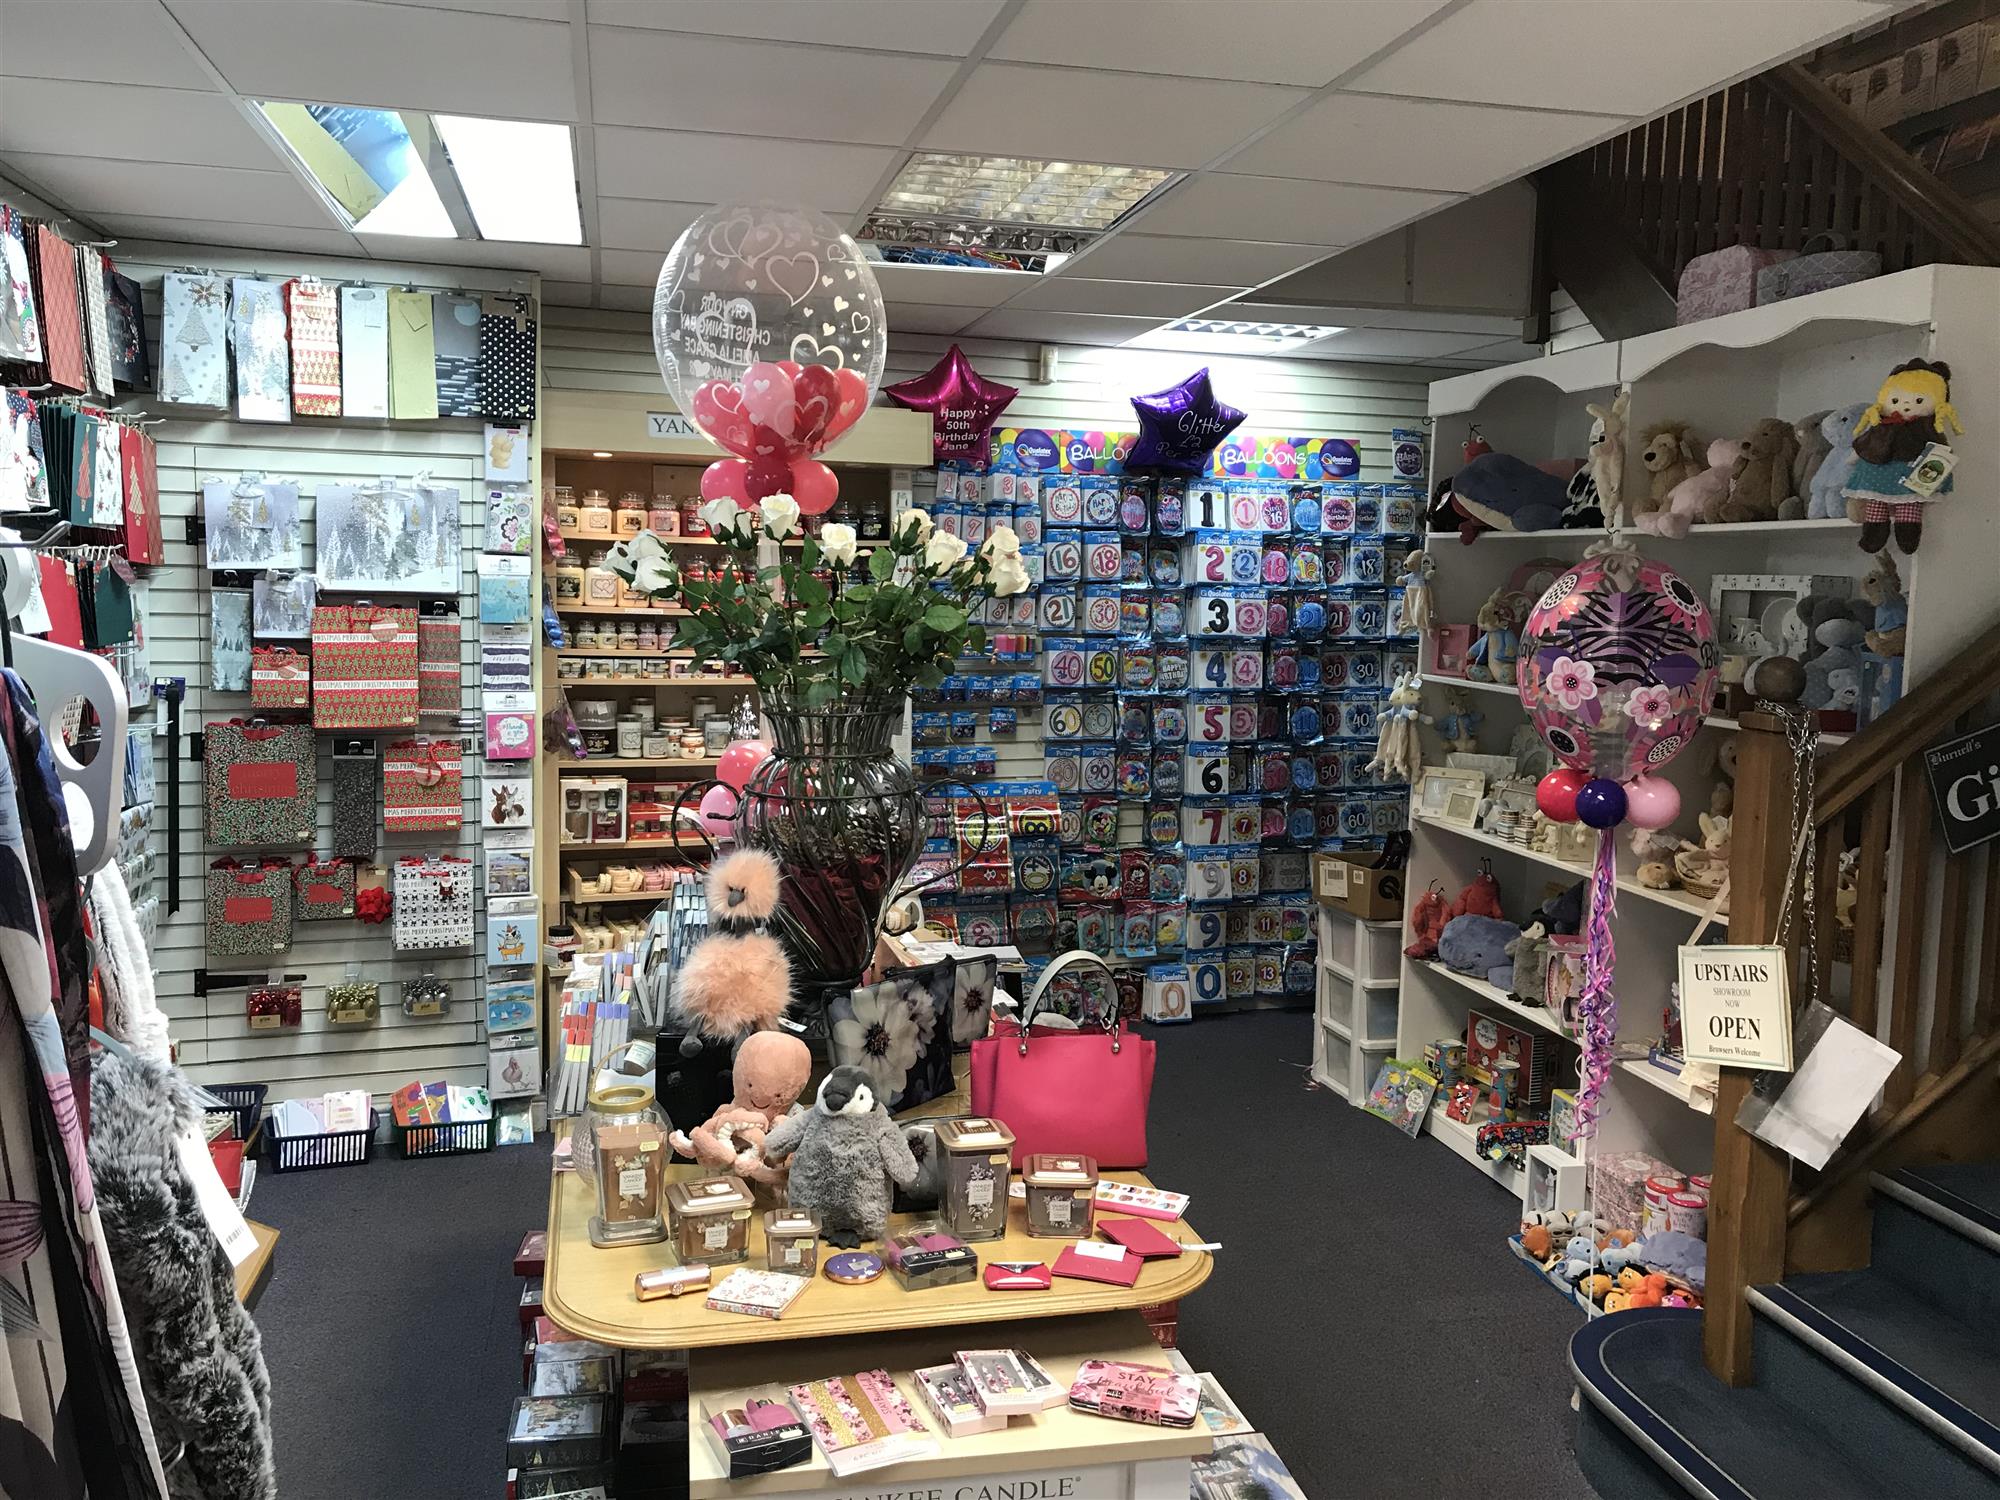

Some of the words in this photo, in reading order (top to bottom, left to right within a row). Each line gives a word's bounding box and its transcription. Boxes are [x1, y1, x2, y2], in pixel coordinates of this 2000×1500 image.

[940, 408, 977, 419] Happy
[1178, 410, 1226, 434] Glitter
[652, 417, 700, 434] YAN
[946, 421, 970, 430] 50th
[934, 432, 980, 442] Birthday
[942, 443, 968, 451] Jane
[1003, 447, 1013, 457] by
[1223, 449, 1307, 466] BALLOONS
[1308, 456, 1318, 466] by
[964, 480, 979, 500] 2
[1003, 476, 1013, 495] 3
[1022, 481, 1035, 500] 4
[1200, 492, 1215, 527] 1
[1241, 502, 1249, 521] 1
[1270, 511, 1283, 524] 16
[944, 516, 955, 534] 6
[969, 518, 982, 537] 7
[1024, 520, 1037, 539] 9
[1205, 537, 1229, 545] Qualatex
[1055, 547, 1077, 571] 16
[1096, 549, 1116, 573] 18
[1205, 545, 1225, 581] 2
[1240, 555, 1250, 572] 2
[1361, 558, 1376, 578] 18
[1265, 558, 1287, 579] 18
[1240, 590, 1265, 599] Qualatex
[1047, 598, 1070, 621] 21
[1208, 598, 1230, 633] 3
[1243, 608, 1256, 626] 3
[1330, 611, 1343, 629] 21
[1362, 611, 1376, 629] 21
[1054, 654, 1081, 681] 40
[1093, 656, 1114, 679] 50
[1205, 651, 1227, 687] 4
[1239, 660, 1252, 678] 4
[1326, 663, 1341, 679] 30
[1356, 662, 1373, 678] 30
[1053, 709, 1077, 734] 60
[1203, 706, 1224, 740] 5
[1236, 712, 1246, 728] 5
[1353, 712, 1369, 728] 40
[1090, 764, 1110, 783] 90
[1202, 758, 1223, 793] 6
[1321, 764, 1337, 780] 50
[1023, 788, 1042, 796] Party
[1202, 809, 1223, 844] 7
[1240, 819, 1248, 833] 7
[1320, 813, 1335, 829] 60
[1348, 812, 1365, 829] 60
[1203, 862, 1225, 898] 9
[1239, 869, 1247, 884] 8
[1200, 913, 1221, 948] 9
[1260, 917, 1271, 931] 11
[1161, 973, 1187, 981] Qualatex
[1195, 964, 1221, 1000] 0
[1231, 970, 1243, 983] 12
[1260, 966, 1274, 980] 13
[1694, 963, 1769, 983] UPSTAIRS
[1161, 982, 1186, 1018] 0
[1712, 988, 1751, 997] SHOWROOM
[1725, 1000, 1740, 1008] NOW
[1709, 1015, 1761, 1041] OPEN
[1708, 1044, 1734, 1055] Browsers
[1734, 1046, 1761, 1057] Welcome
[1118, 1371, 1157, 1384] STAY
